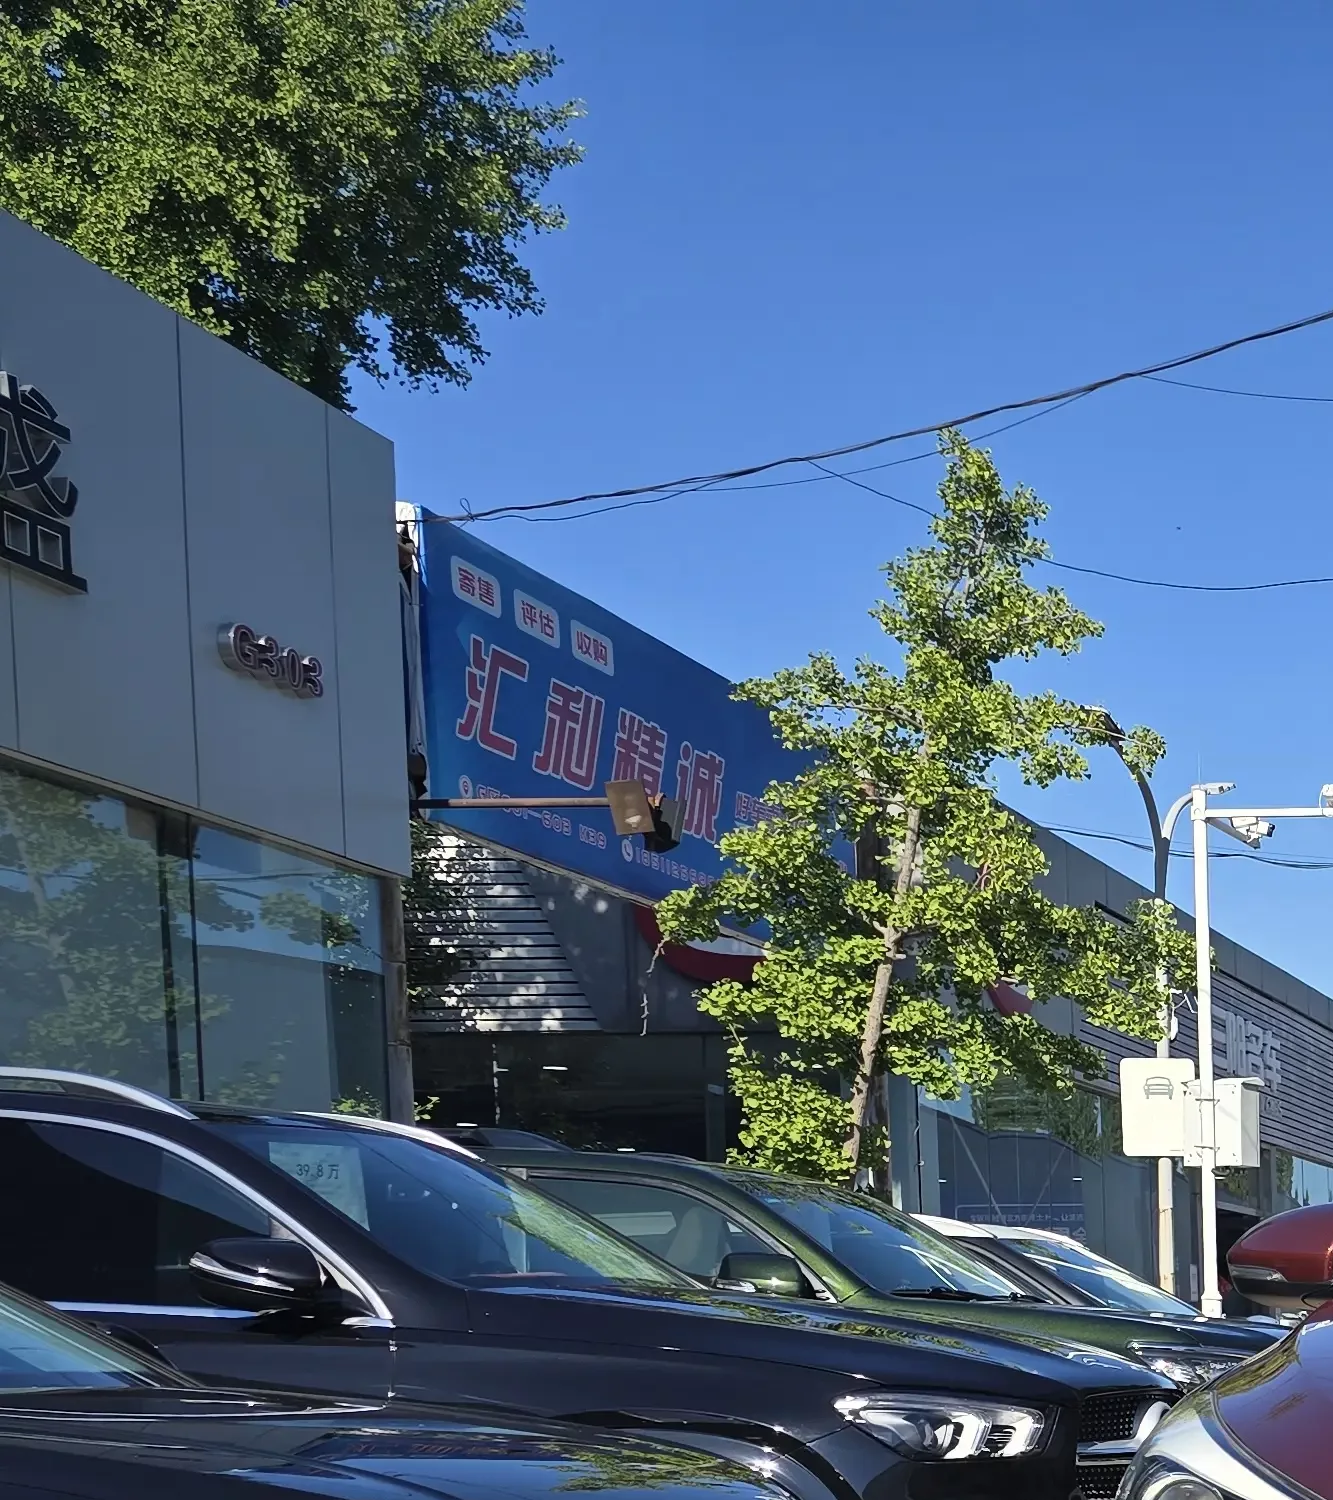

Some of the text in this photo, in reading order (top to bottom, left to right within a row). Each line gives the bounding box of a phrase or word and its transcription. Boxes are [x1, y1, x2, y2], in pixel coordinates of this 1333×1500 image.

[230, 622, 324, 699] G303
[457, 566, 608, 667] 寄售 评估 收购
[456, 633, 725, 844] 汇利精诚
